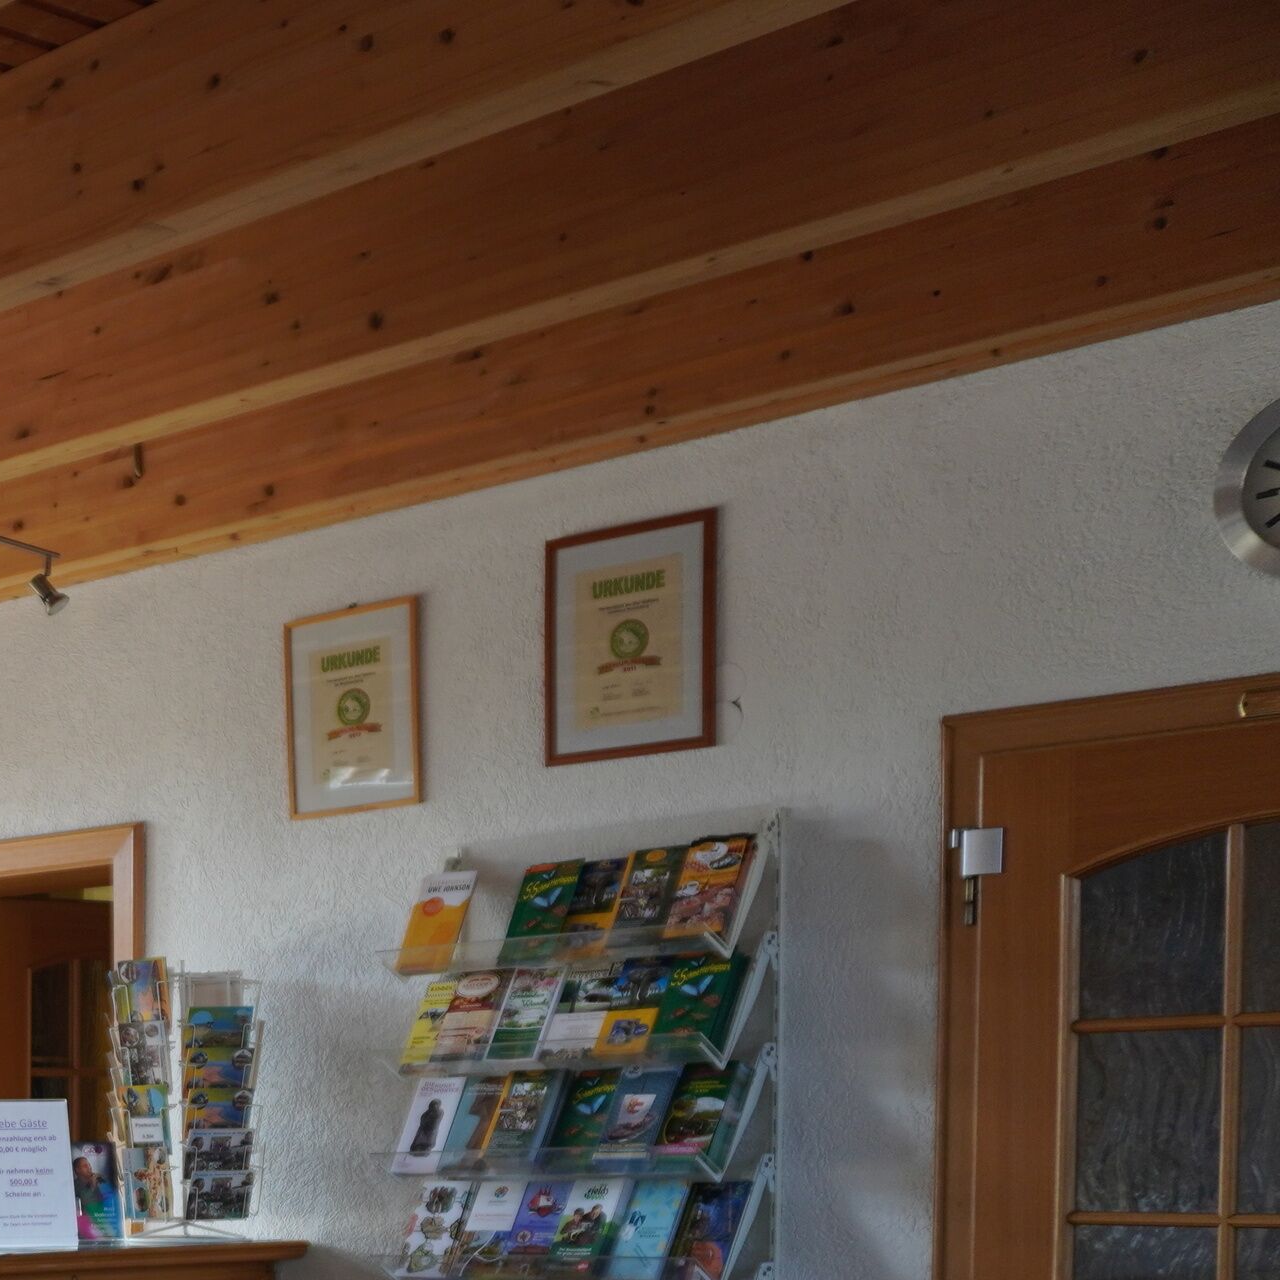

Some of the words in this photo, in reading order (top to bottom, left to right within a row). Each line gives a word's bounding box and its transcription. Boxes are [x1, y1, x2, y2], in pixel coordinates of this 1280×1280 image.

[592, 569, 665, 599] URKUNDE
[320, 645, 381, 672] URKUNDE
[20, 1118, 48, 1129] Gäste
[20, 1146, 48, 1154] möglich
